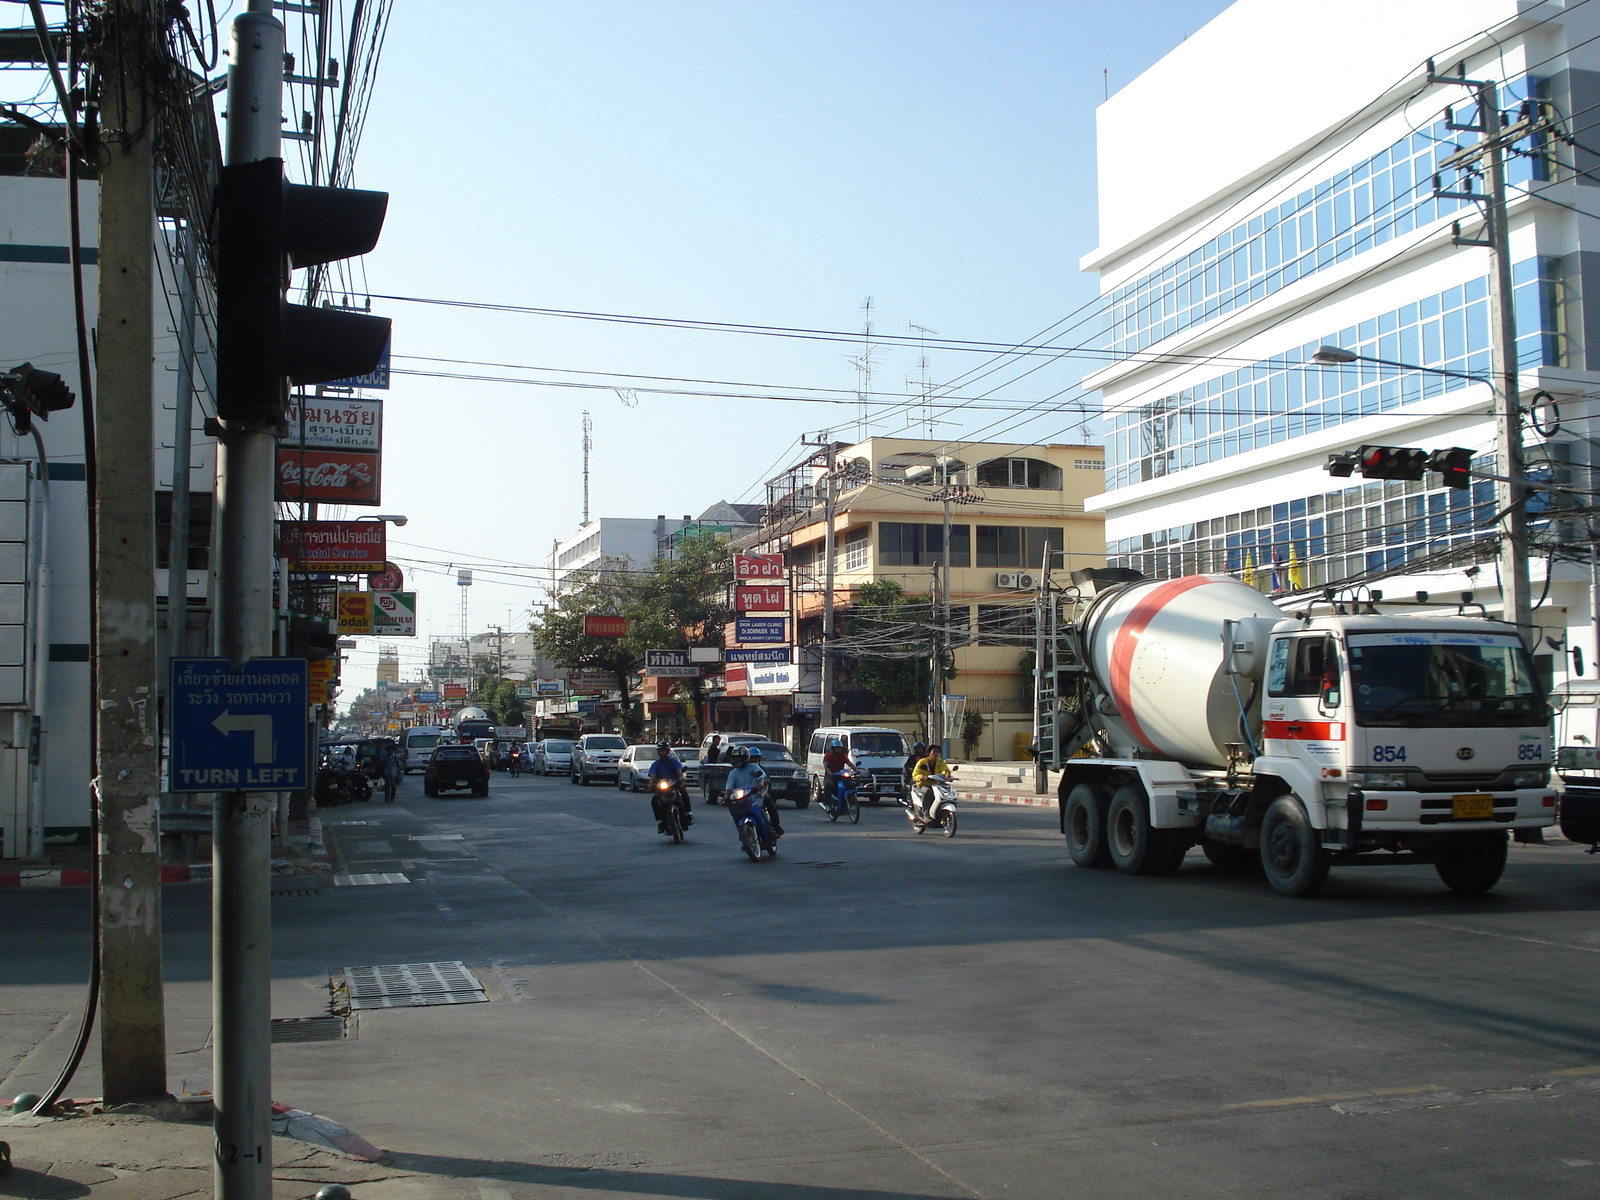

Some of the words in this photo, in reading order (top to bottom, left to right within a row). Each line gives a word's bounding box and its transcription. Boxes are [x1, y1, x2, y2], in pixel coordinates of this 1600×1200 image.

[332, 547, 368, 558] Service
[742, 593, 762, 609] หูด
[375, 616, 412, 624] FUJIFILM
[650, 651, 684, 666] ทำฟัน
[730, 649, 785, 661] แพทย์สมนึก
[188, 688, 219, 704] ระวัง
[226, 692, 291, 704] รถทางขวา
[1373, 745, 1407, 762] 854
[1518, 744, 1542, 760] 854
[180, 769, 240, 783] TURN
[246, 768, 298, 783] LEFT
